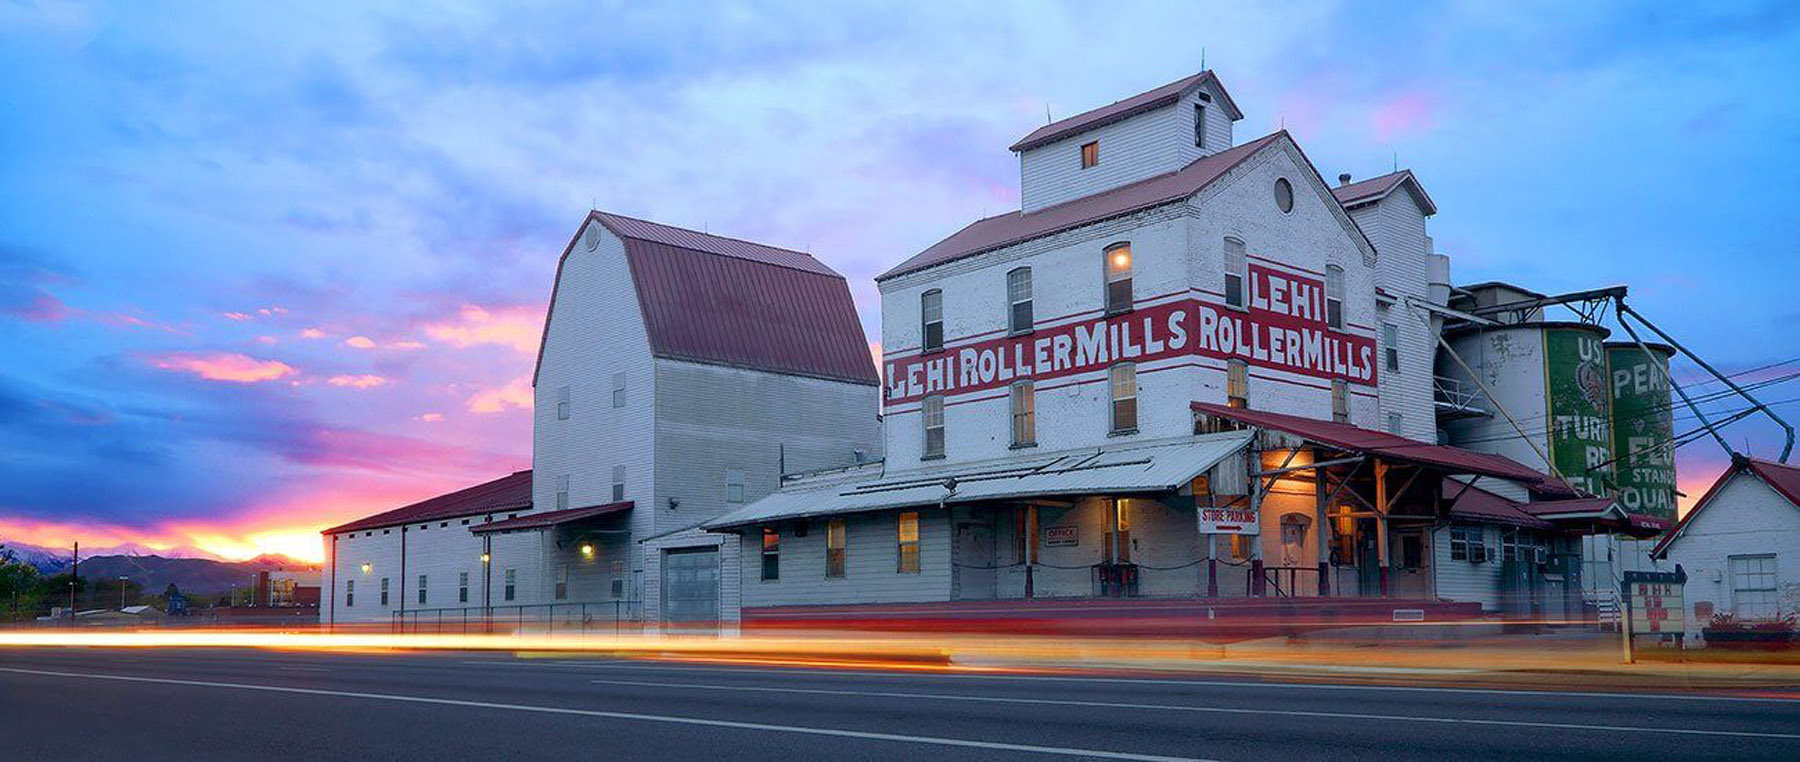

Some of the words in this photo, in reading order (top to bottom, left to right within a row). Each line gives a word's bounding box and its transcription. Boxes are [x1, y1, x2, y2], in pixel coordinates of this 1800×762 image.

[1251, 272, 1321, 321] LEHI
[886, 356, 955, 400] LEHI
[960, 335, 1072, 388] ROLLER
[1075, 311, 1187, 367] MILLS
[1199, 306, 1302, 367] ROLLER
[1302, 328, 1372, 380] MILLS
[1202, 509, 1225, 522] STORE
[1226, 510, 1256, 523] PARKING
